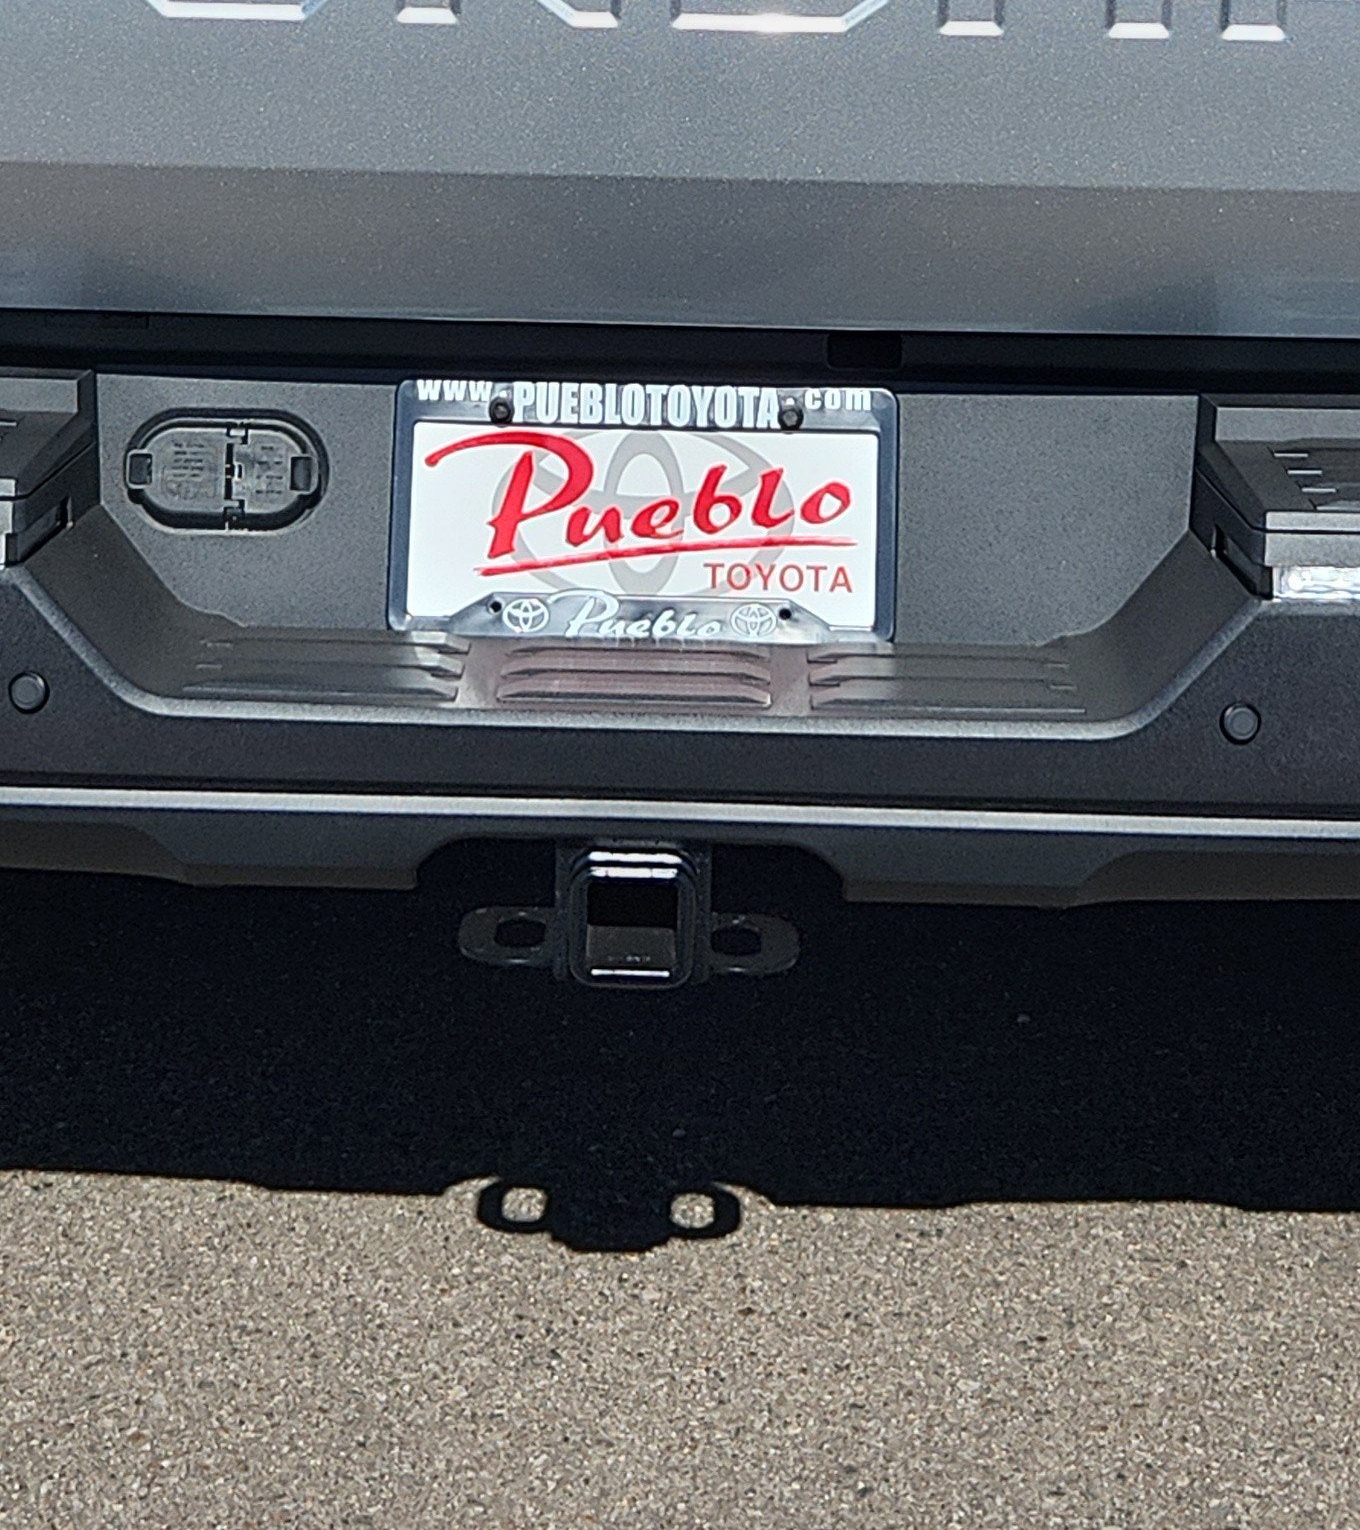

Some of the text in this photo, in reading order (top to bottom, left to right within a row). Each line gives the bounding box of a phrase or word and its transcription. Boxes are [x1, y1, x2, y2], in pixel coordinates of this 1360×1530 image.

[424, 431, 853, 560] Pueblo
[703, 561, 854, 594] TOYOTA
[548, 588, 726, 638] Pueblo
